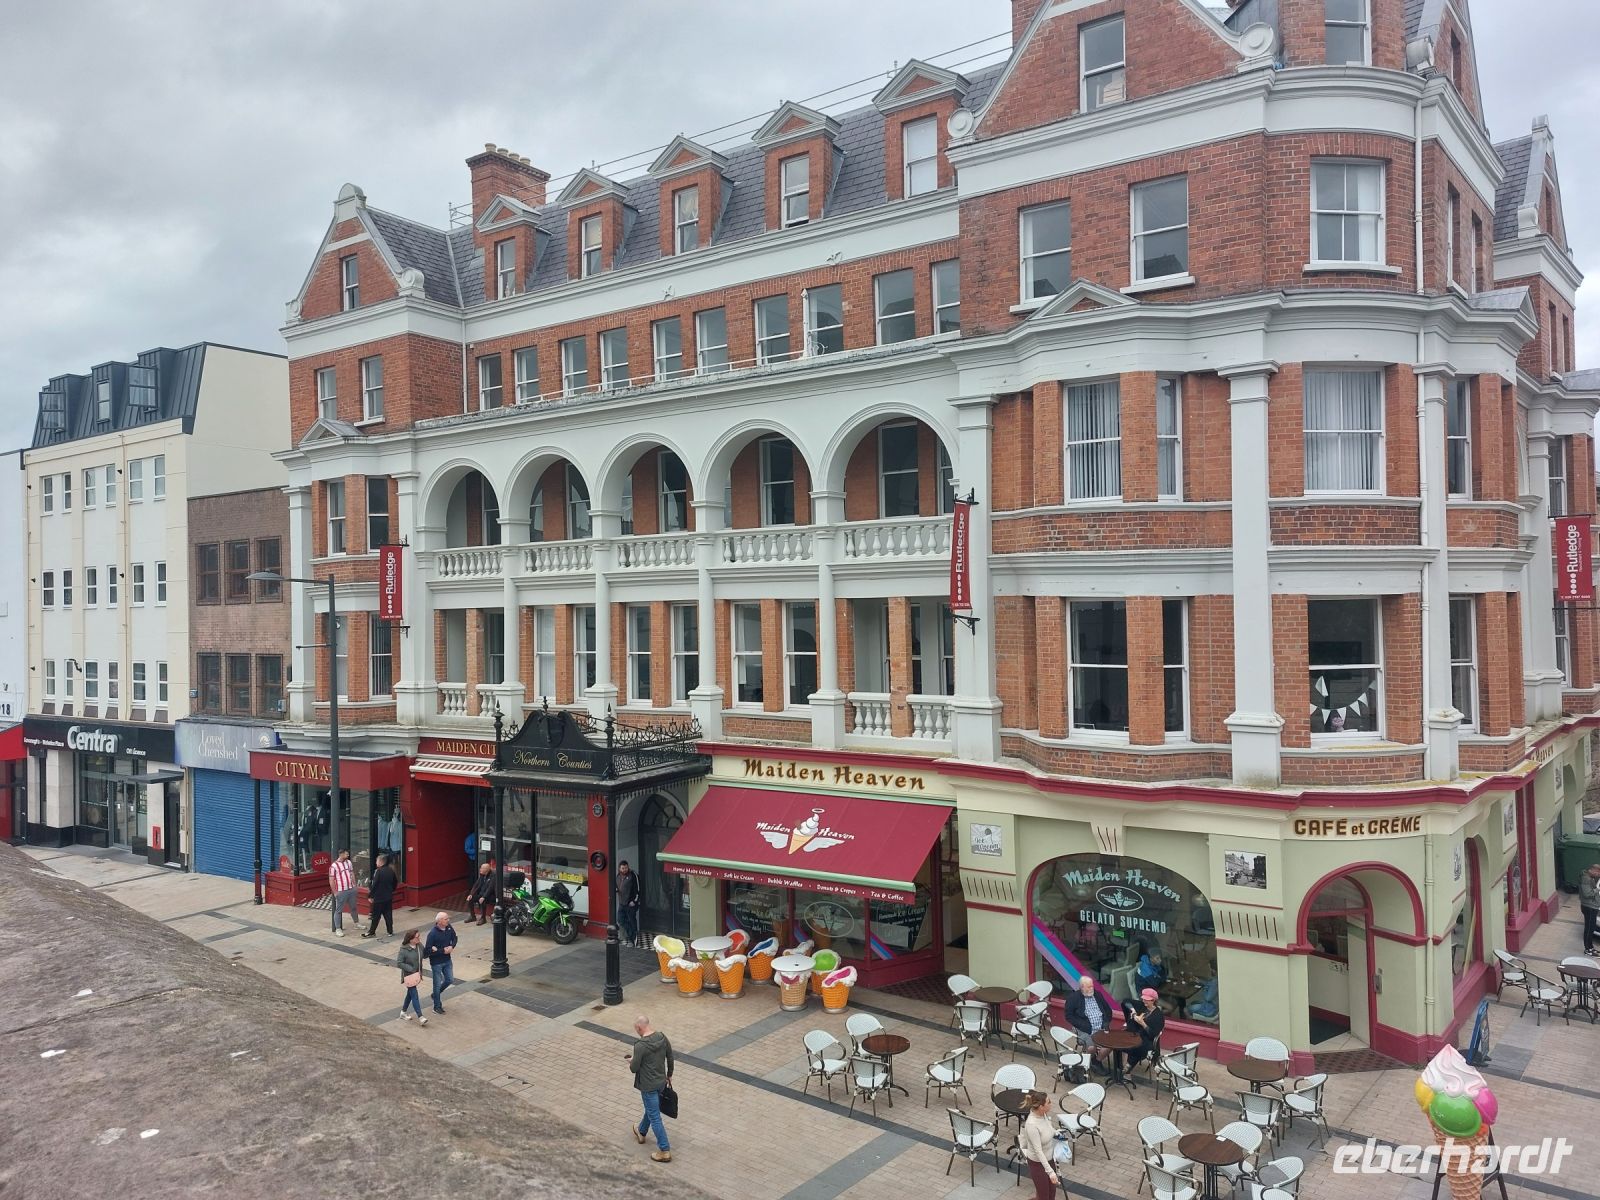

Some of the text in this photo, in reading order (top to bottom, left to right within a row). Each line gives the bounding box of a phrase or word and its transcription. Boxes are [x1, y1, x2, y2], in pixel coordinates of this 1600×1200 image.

[955, 512, 965, 573] Rutledge
[1566, 524, 1580, 573] Rutledge
[386, 552, 396, 594] Rutledge
[67, 725, 119, 754] Centra
[201, 729, 225, 746] Loved
[436, 741, 477, 754] MAIDEN
[198, 743, 239, 760] Cherished
[512, 749, 592, 769] Northern Counties
[275, 760, 332, 781] CITYMA
[744, 758, 925, 790] Maiden Heaven
[755, 822, 855, 840] Maiden Heaven
[1294, 818, 1348, 836] CAFÉ
[1351, 823, 1365, 835] et
[314, 856, 328, 866] sale
[783, 879, 803, 888] Waffles
[887, 893, 904, 901] Coffee
[1063, 866, 1181, 903] Maiden Heaven
[1080, 909, 1167, 934] GELATO SUPREMO
